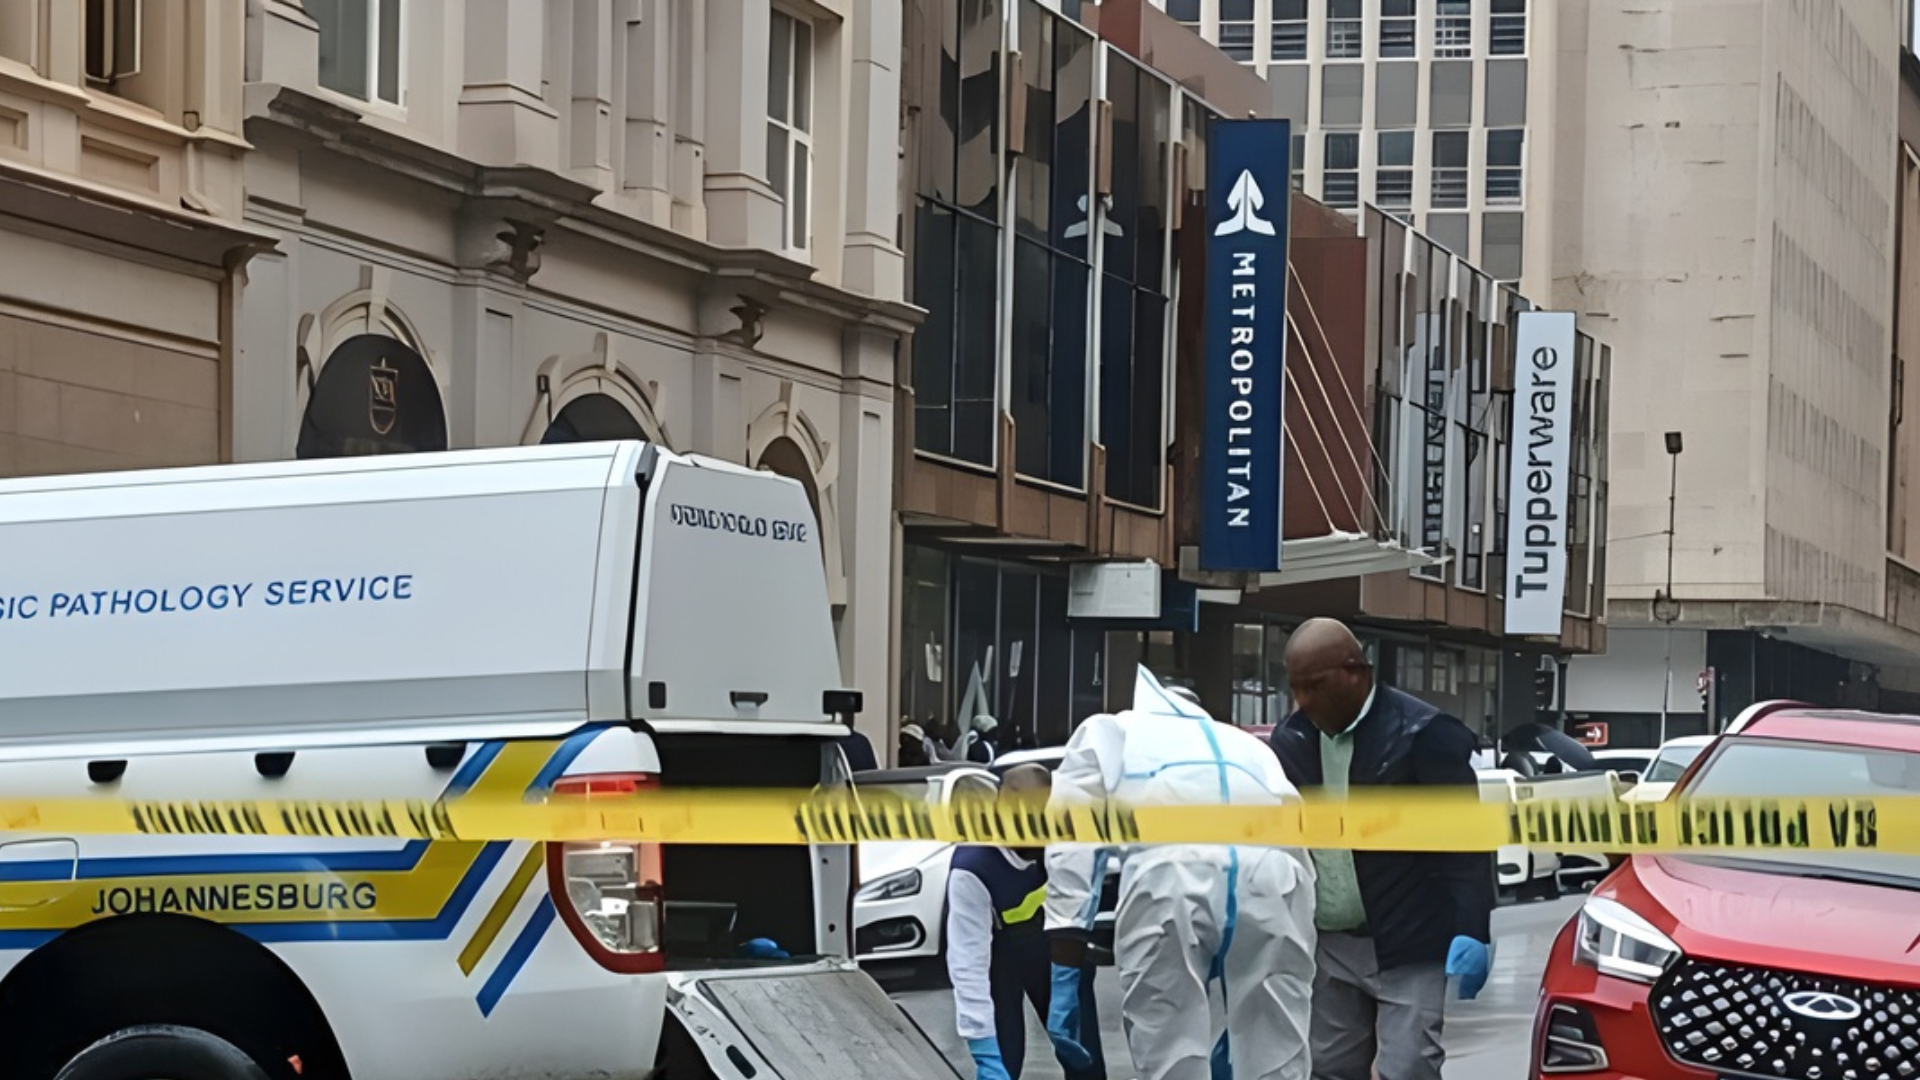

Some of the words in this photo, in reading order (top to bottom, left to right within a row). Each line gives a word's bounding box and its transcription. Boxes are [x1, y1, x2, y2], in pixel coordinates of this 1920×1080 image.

[1227, 252, 1256, 528] METROPOLITAN
[1515, 345, 1558, 599] Tupperware
[49, 583, 253, 617] PATHOLOGY
[264, 574, 413, 606] SERVICE
[92, 882, 376, 914] JOHANNESBURG
